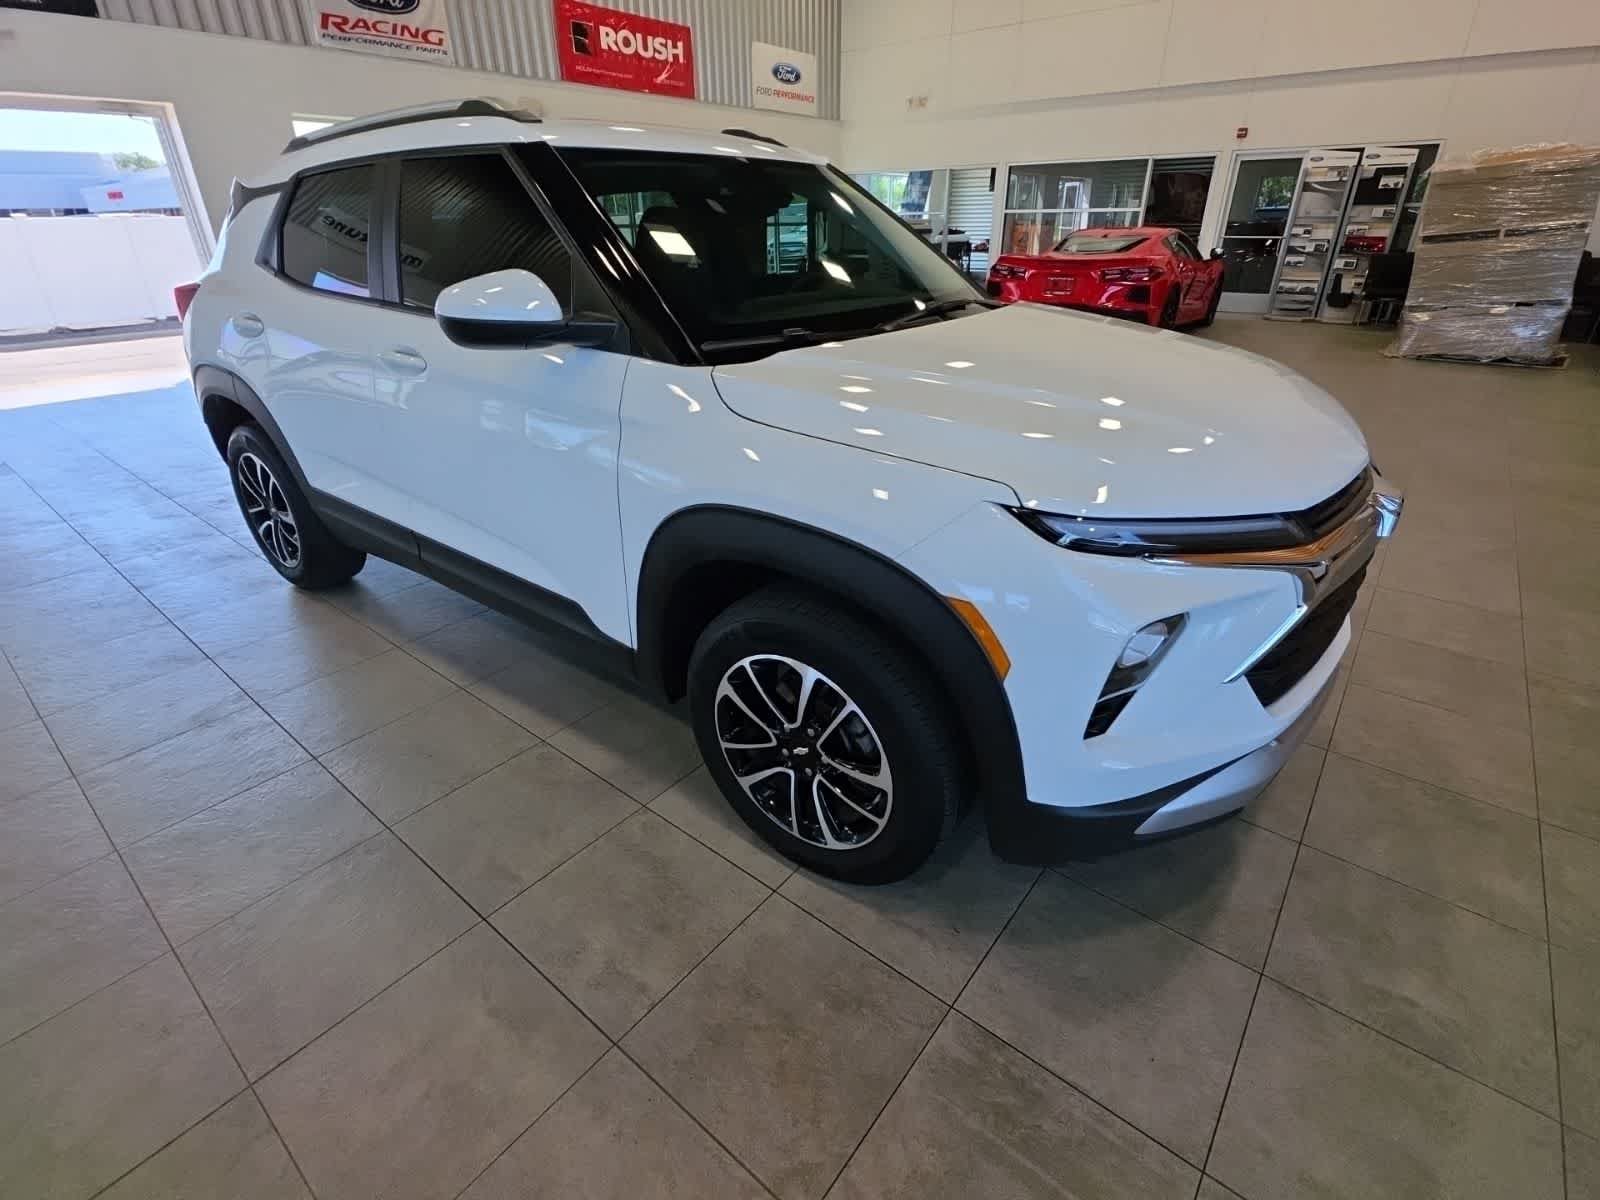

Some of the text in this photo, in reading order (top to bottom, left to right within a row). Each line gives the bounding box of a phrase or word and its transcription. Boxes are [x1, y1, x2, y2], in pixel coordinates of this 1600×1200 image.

[320, 12, 445, 46] RACING
[322, 32, 448, 56] PERFORMANCE PARTS
[599, 25, 684, 64] ROUSH
[777, 65, 797, 82] Ford
